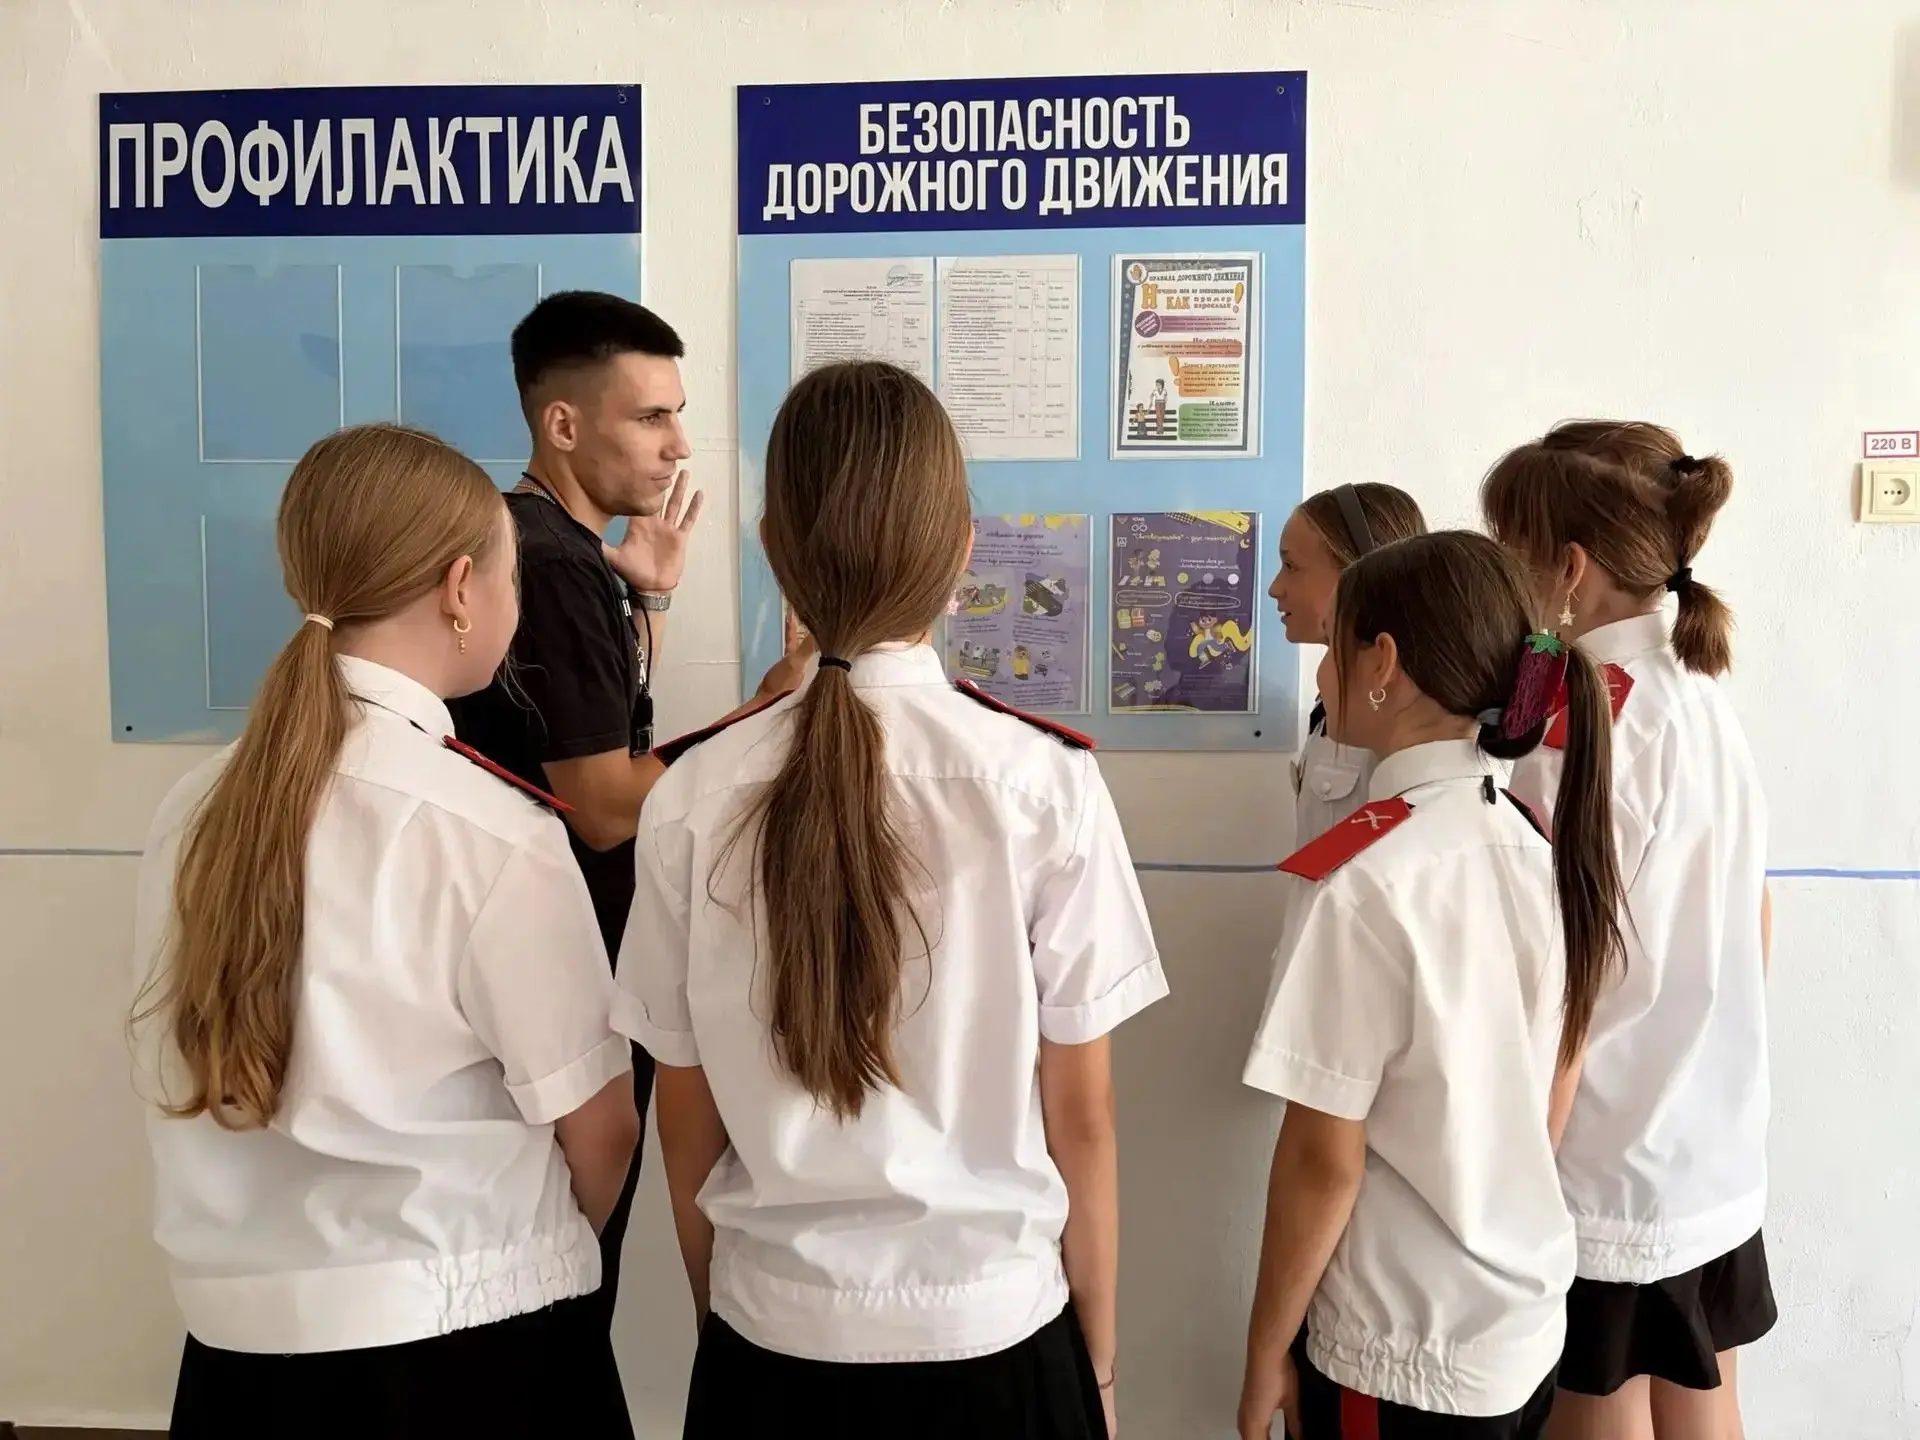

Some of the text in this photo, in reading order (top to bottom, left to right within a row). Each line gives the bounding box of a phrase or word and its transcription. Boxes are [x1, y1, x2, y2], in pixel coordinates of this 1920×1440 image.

[858, 95, 1191, 155] БЕЗОПАСНОСТЬ
[108, 115, 635, 209] ПРОФИЛАКТИКА
[762, 152, 1289, 221] ДОРОЖНОГО ДВИЖЕНИЯ
[1177, 272, 1212, 282] ДОРОЖНОГО
[1166, 296, 1191, 310] КАК
[1871, 438, 1897, 450] 220
